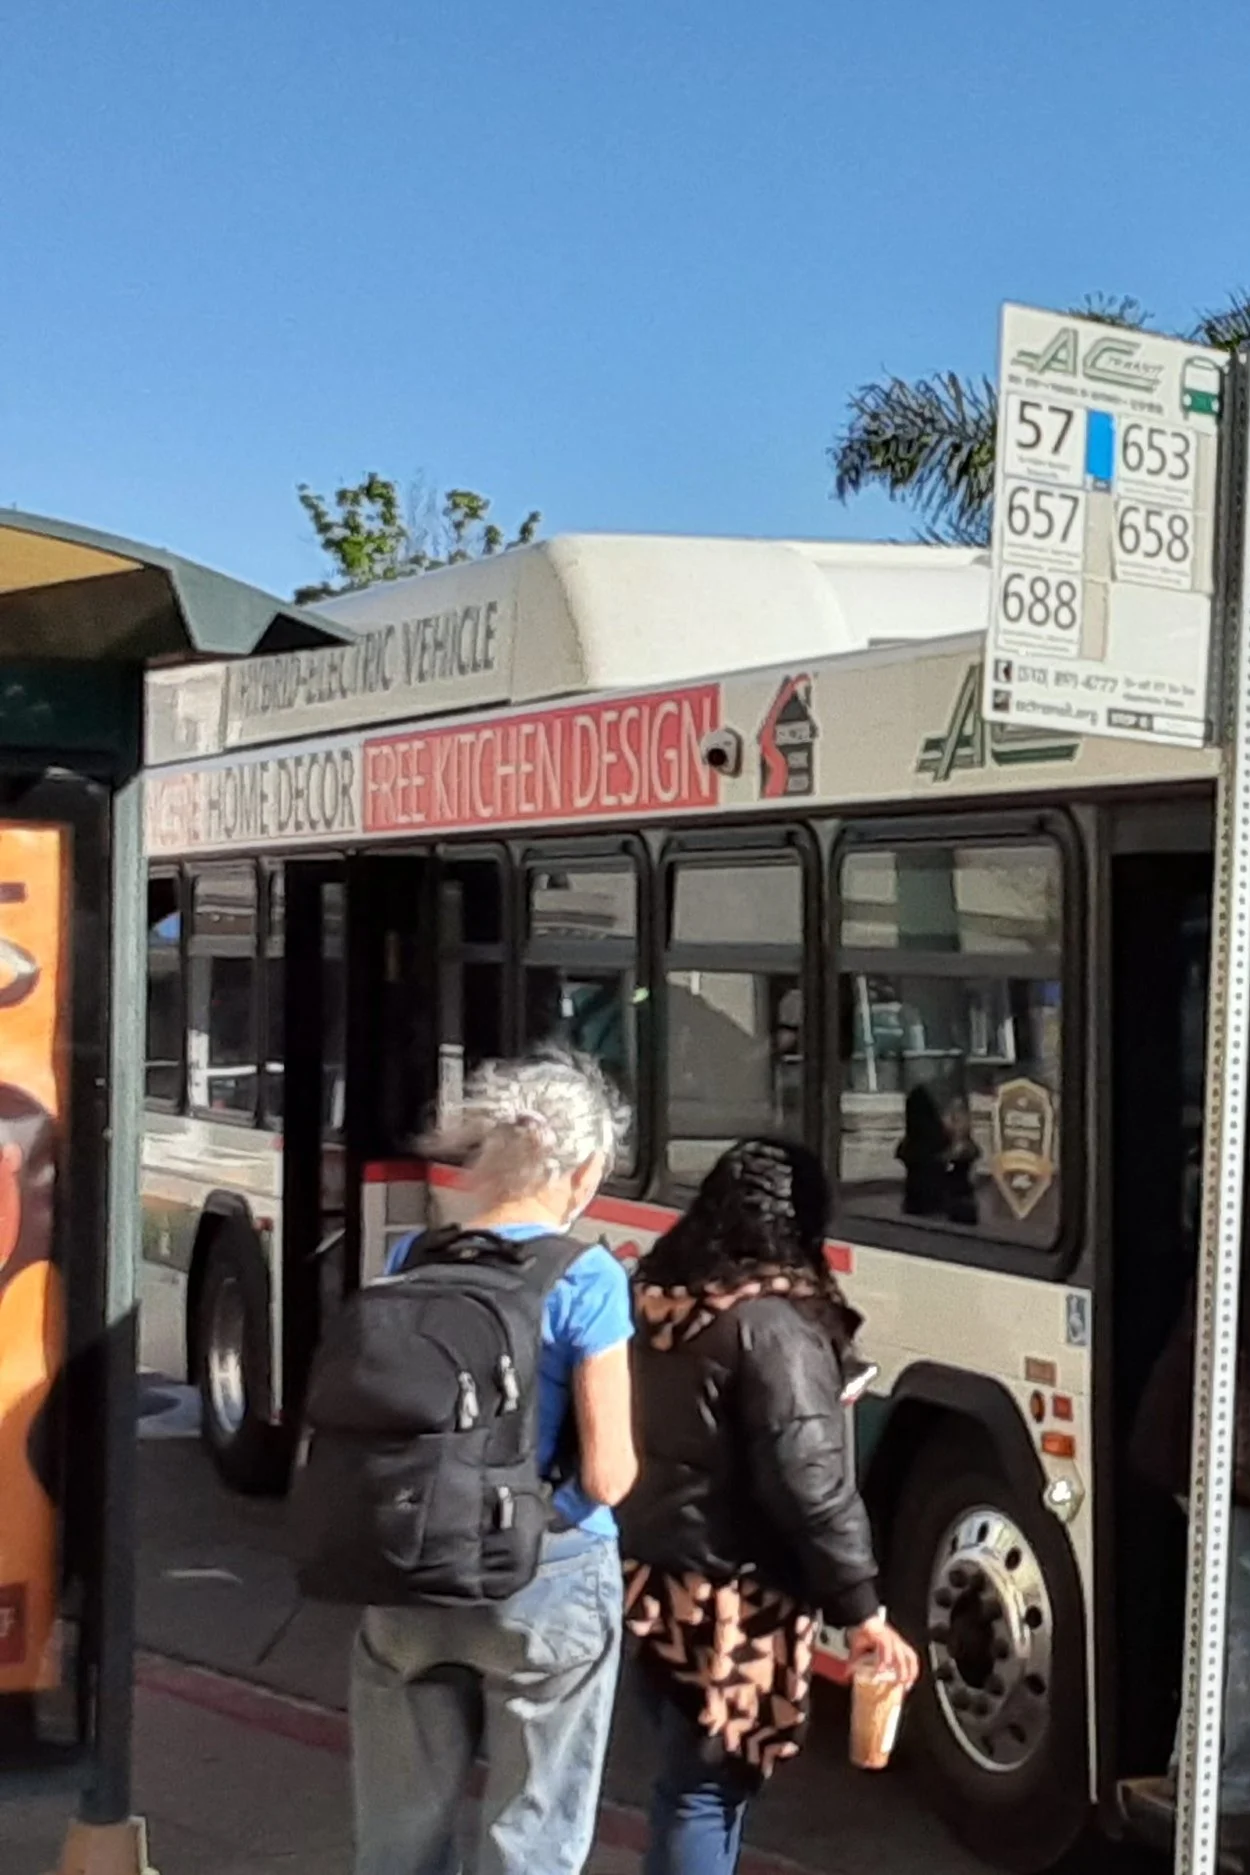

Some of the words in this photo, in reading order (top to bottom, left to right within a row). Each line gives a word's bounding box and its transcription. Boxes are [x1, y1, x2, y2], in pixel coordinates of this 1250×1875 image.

[1016, 401, 1074, 456] 57
[1122, 423, 1190, 480] 653
[1007, 486, 1079, 543] 657
[1118, 505, 1190, 563] 658
[1002, 573, 1077, 630] 688
[403, 600, 498, 687] VEHICLE
[206, 760, 269, 841] HOME
[277, 748, 356, 834] DECOR
[364, 740, 426, 829] FREE
[433, 717, 564, 822] KITCHEN
[573, 696, 713, 809] DESIGN
